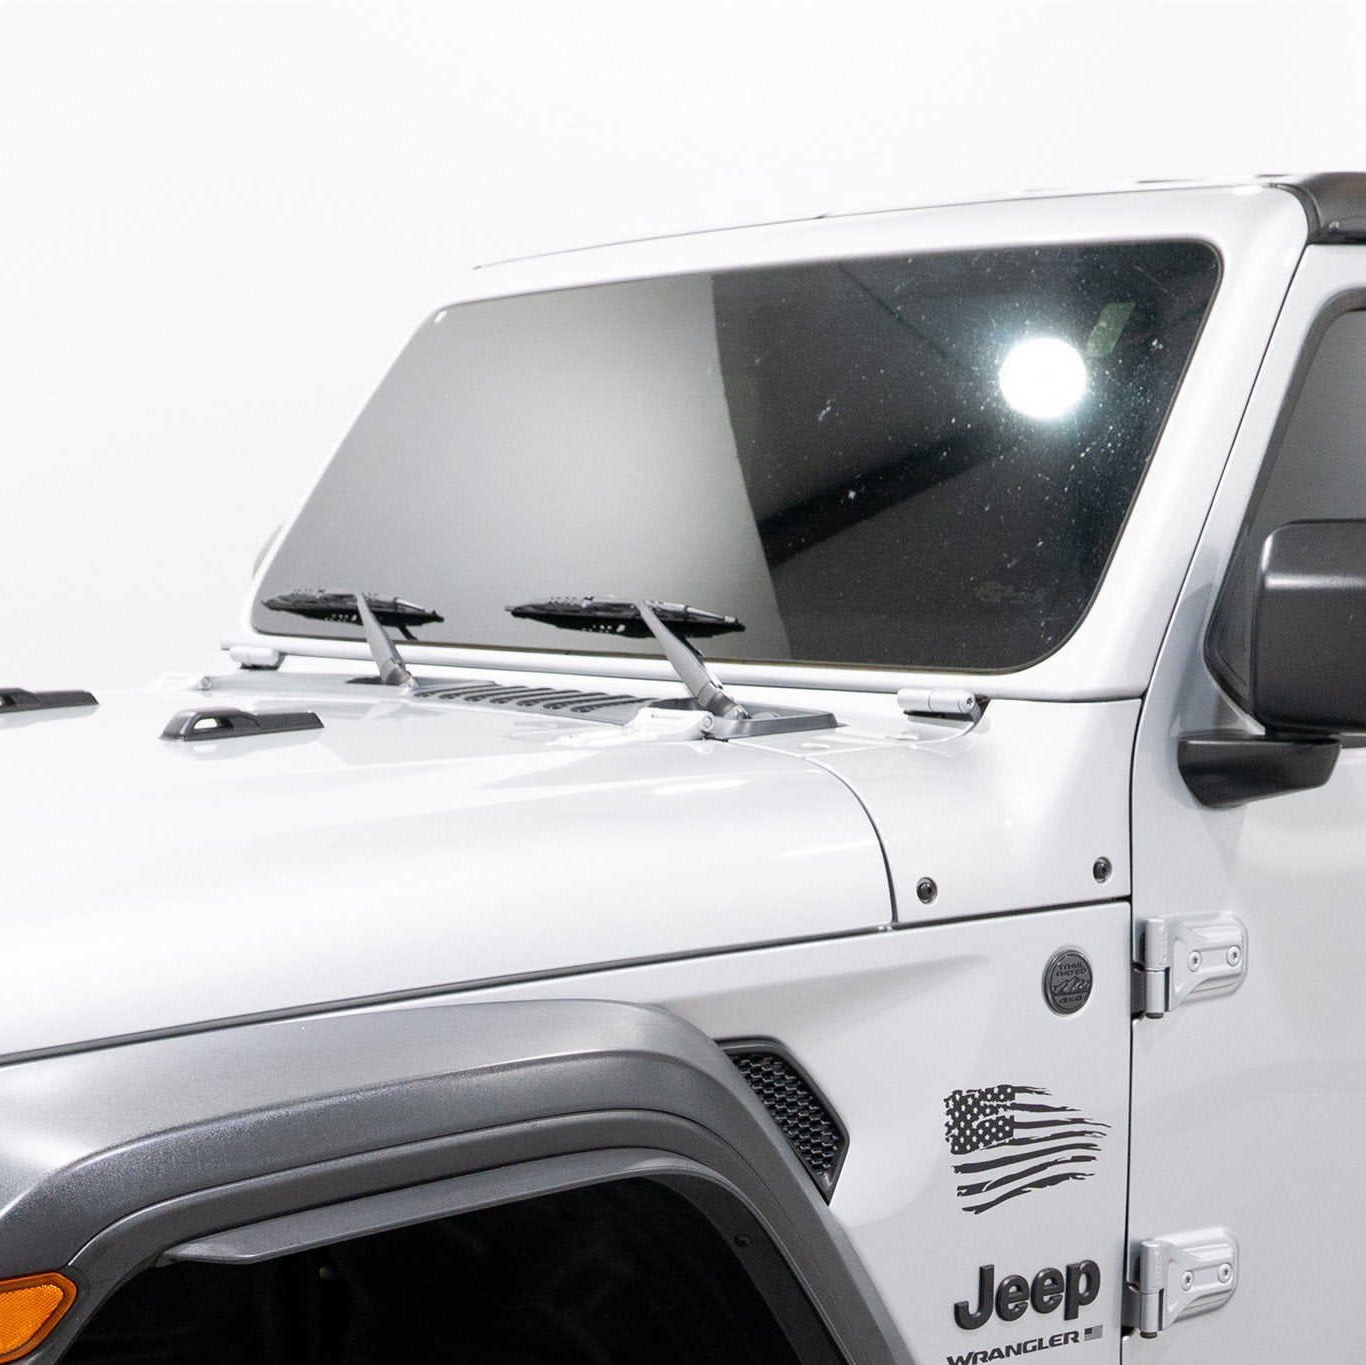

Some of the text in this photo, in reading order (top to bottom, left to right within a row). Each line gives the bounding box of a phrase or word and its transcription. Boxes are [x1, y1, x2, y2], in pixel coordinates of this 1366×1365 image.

[1057, 962, 1084, 971] TRAIL
[1055, 968, 1087, 977] RATED
[953, 1259, 1102, 1331] Jeep
